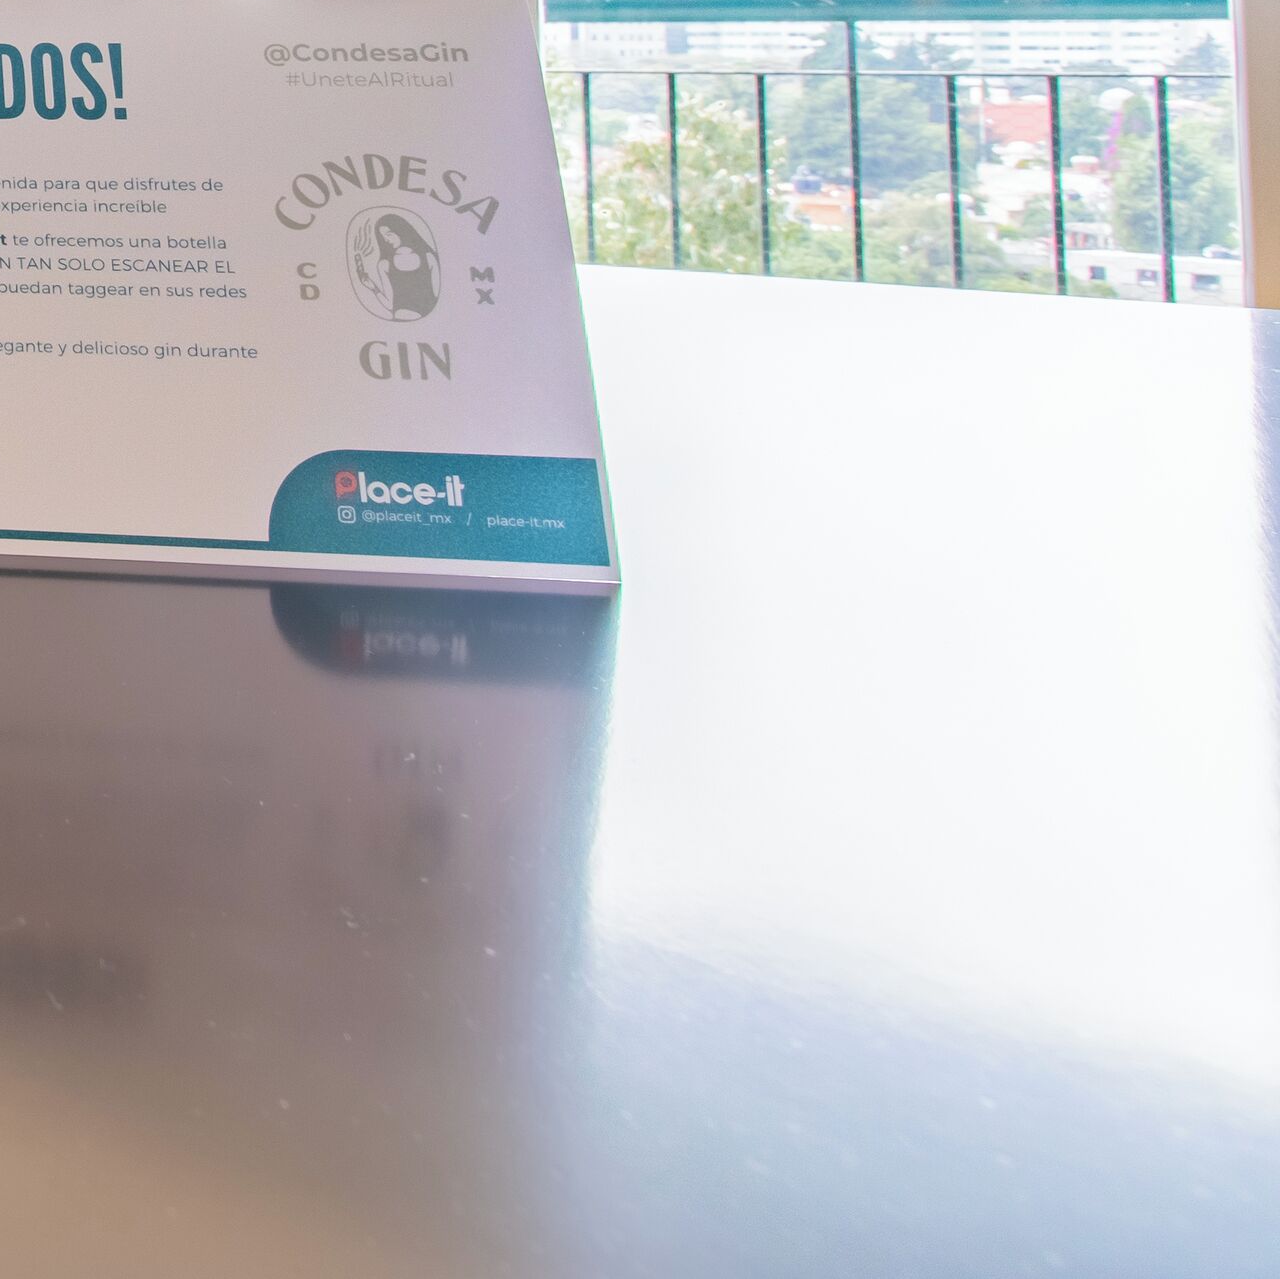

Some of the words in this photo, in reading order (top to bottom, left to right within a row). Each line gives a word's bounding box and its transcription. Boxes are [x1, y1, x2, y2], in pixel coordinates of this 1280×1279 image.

[263, 42, 470, 66] @CondesaGin
[285, 70, 454, 89] #UneteAlRitual
[44, 179, 80, 192] para
[86, 179, 119, 193] que
[124, 178, 196, 191] disfrutes
[201, 178, 224, 191] de
[274, 153, 500, 235] CONDESA
[93, 199, 167, 213] increíble
[13, 235, 29, 247] te
[34, 234, 124, 248] ofrecemos
[129, 238, 163, 249] una
[167, 235, 226, 249] botella
[17, 257, 52, 270] TAN
[58, 258, 105, 271] SOLO
[111, 259, 208, 272] ESCANEAR
[215, 260, 235, 273] EL
[68, 283, 134, 298] taggear
[139, 286, 160, 296] en
[166, 287, 193, 297] sus
[199, 285, 247, 298] redes
[58, 343, 67, 355] y
[72, 340, 149, 355] delicioso
[154, 345, 181, 360] gin
[187, 343, 258, 359] durante
[359, 340, 452, 382] GIN
[335, 471, 464, 507] Place-it
[362, 509, 452, 526] @placeit_mx
